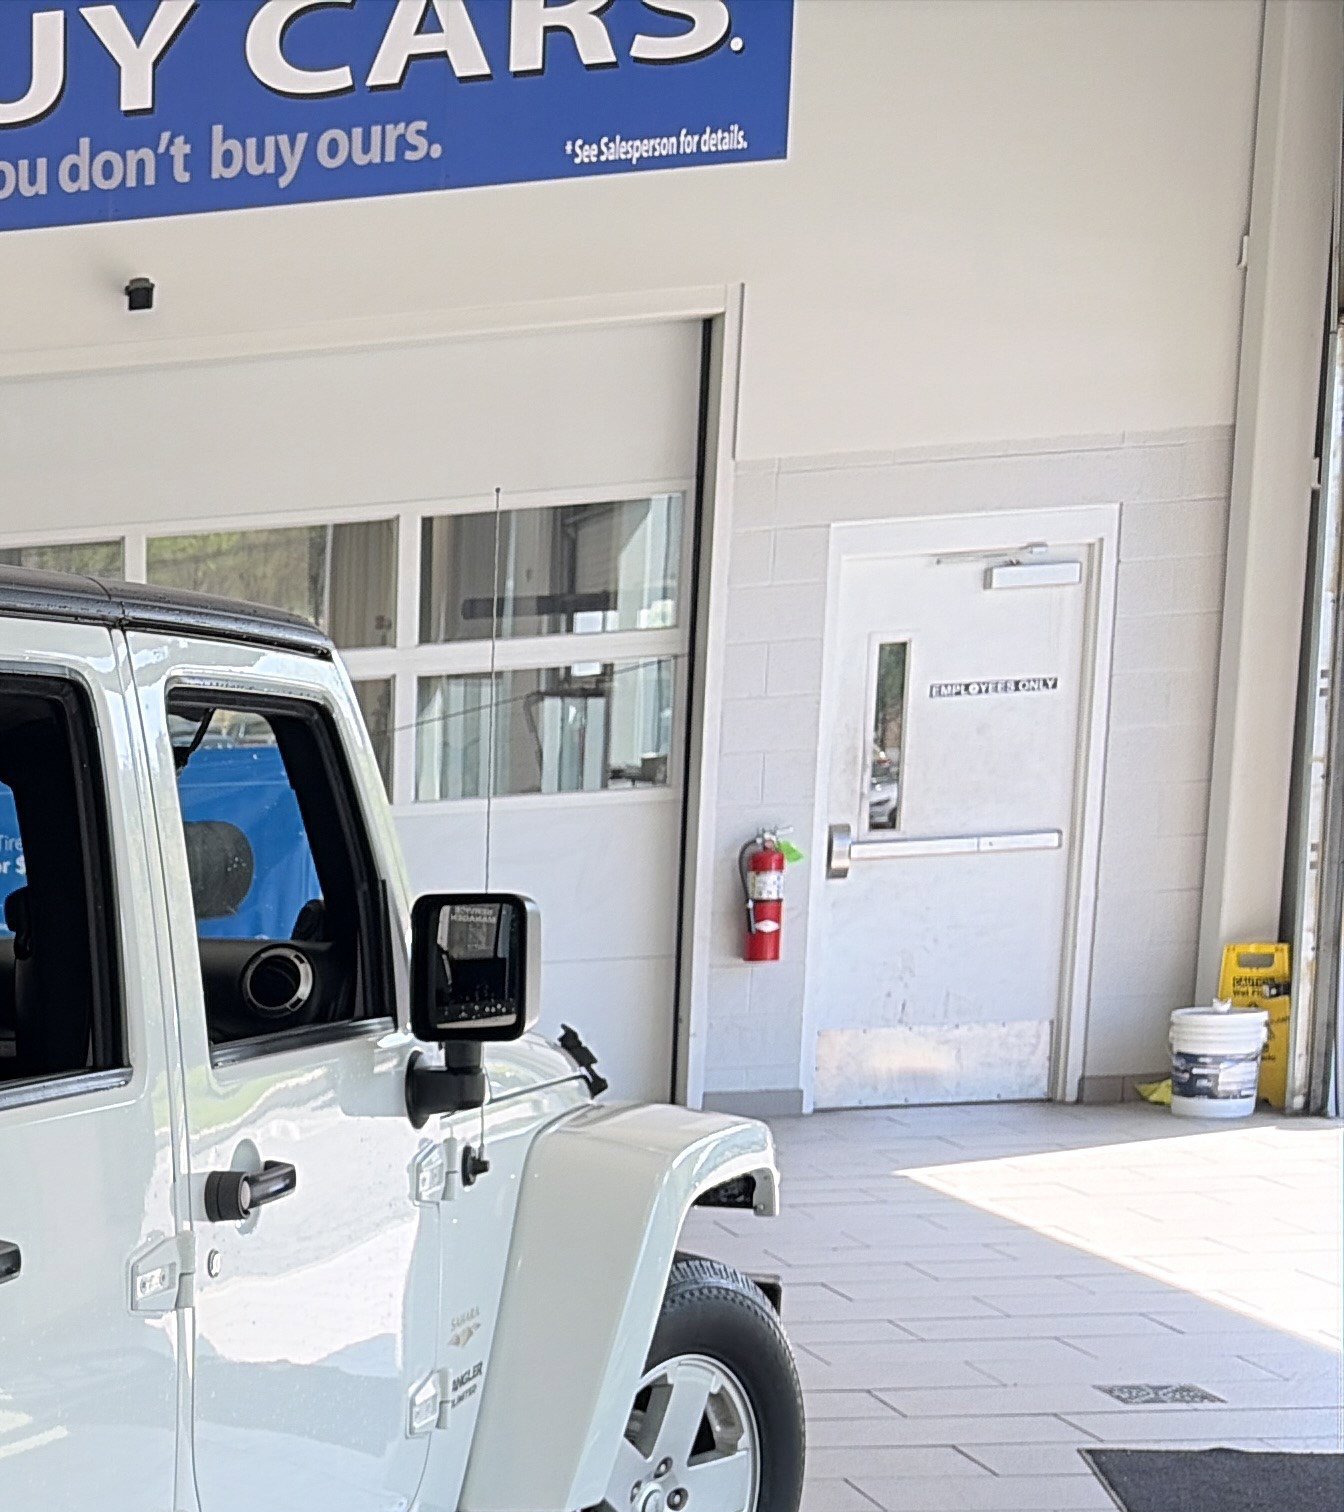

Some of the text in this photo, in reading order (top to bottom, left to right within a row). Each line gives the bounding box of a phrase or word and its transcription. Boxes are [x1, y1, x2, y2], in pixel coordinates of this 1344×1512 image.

[245, 0, 745, 97] CARS.
[58, 131, 191, 194] don't
[211, 125, 308, 189] buy
[317, 119, 443, 168] ours.
[600, 135, 677, 164] Salesperson
[679, 128, 699, 154] for
[700, 124, 748, 152] details.
[931, 677, 1057, 698] EMPLOYEES ONLY
[452, 1361, 483, 1392] ANGLER
